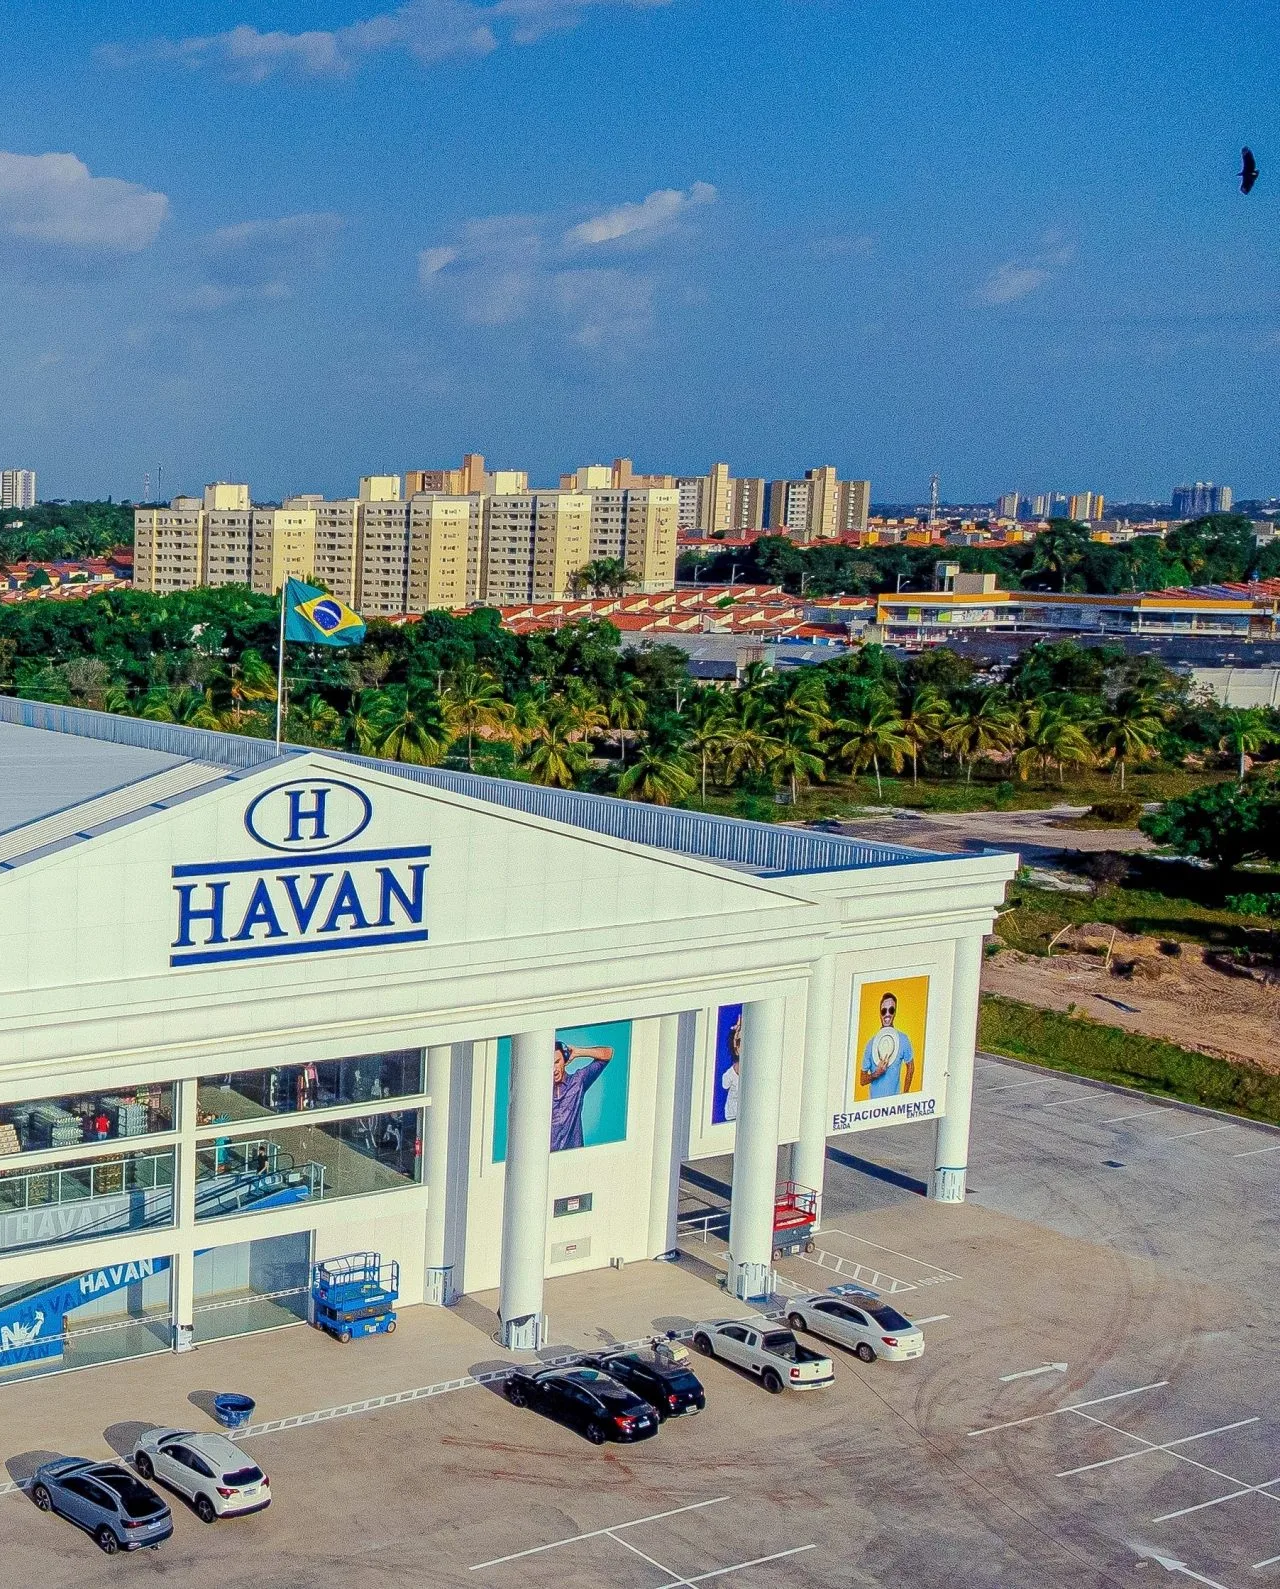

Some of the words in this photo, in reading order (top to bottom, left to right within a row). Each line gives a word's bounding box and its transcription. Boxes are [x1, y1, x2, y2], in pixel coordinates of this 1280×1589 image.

[283, 788, 331, 842] H
[170, 863, 430, 948] HAVAN
[833, 1099, 936, 1125] ESTACIONAMENTO
[906, 1108, 935, 1119] ENTRADA
[16, 1204, 117, 1240] HAVAN
[79, 1258, 154, 1295] HAVAN
